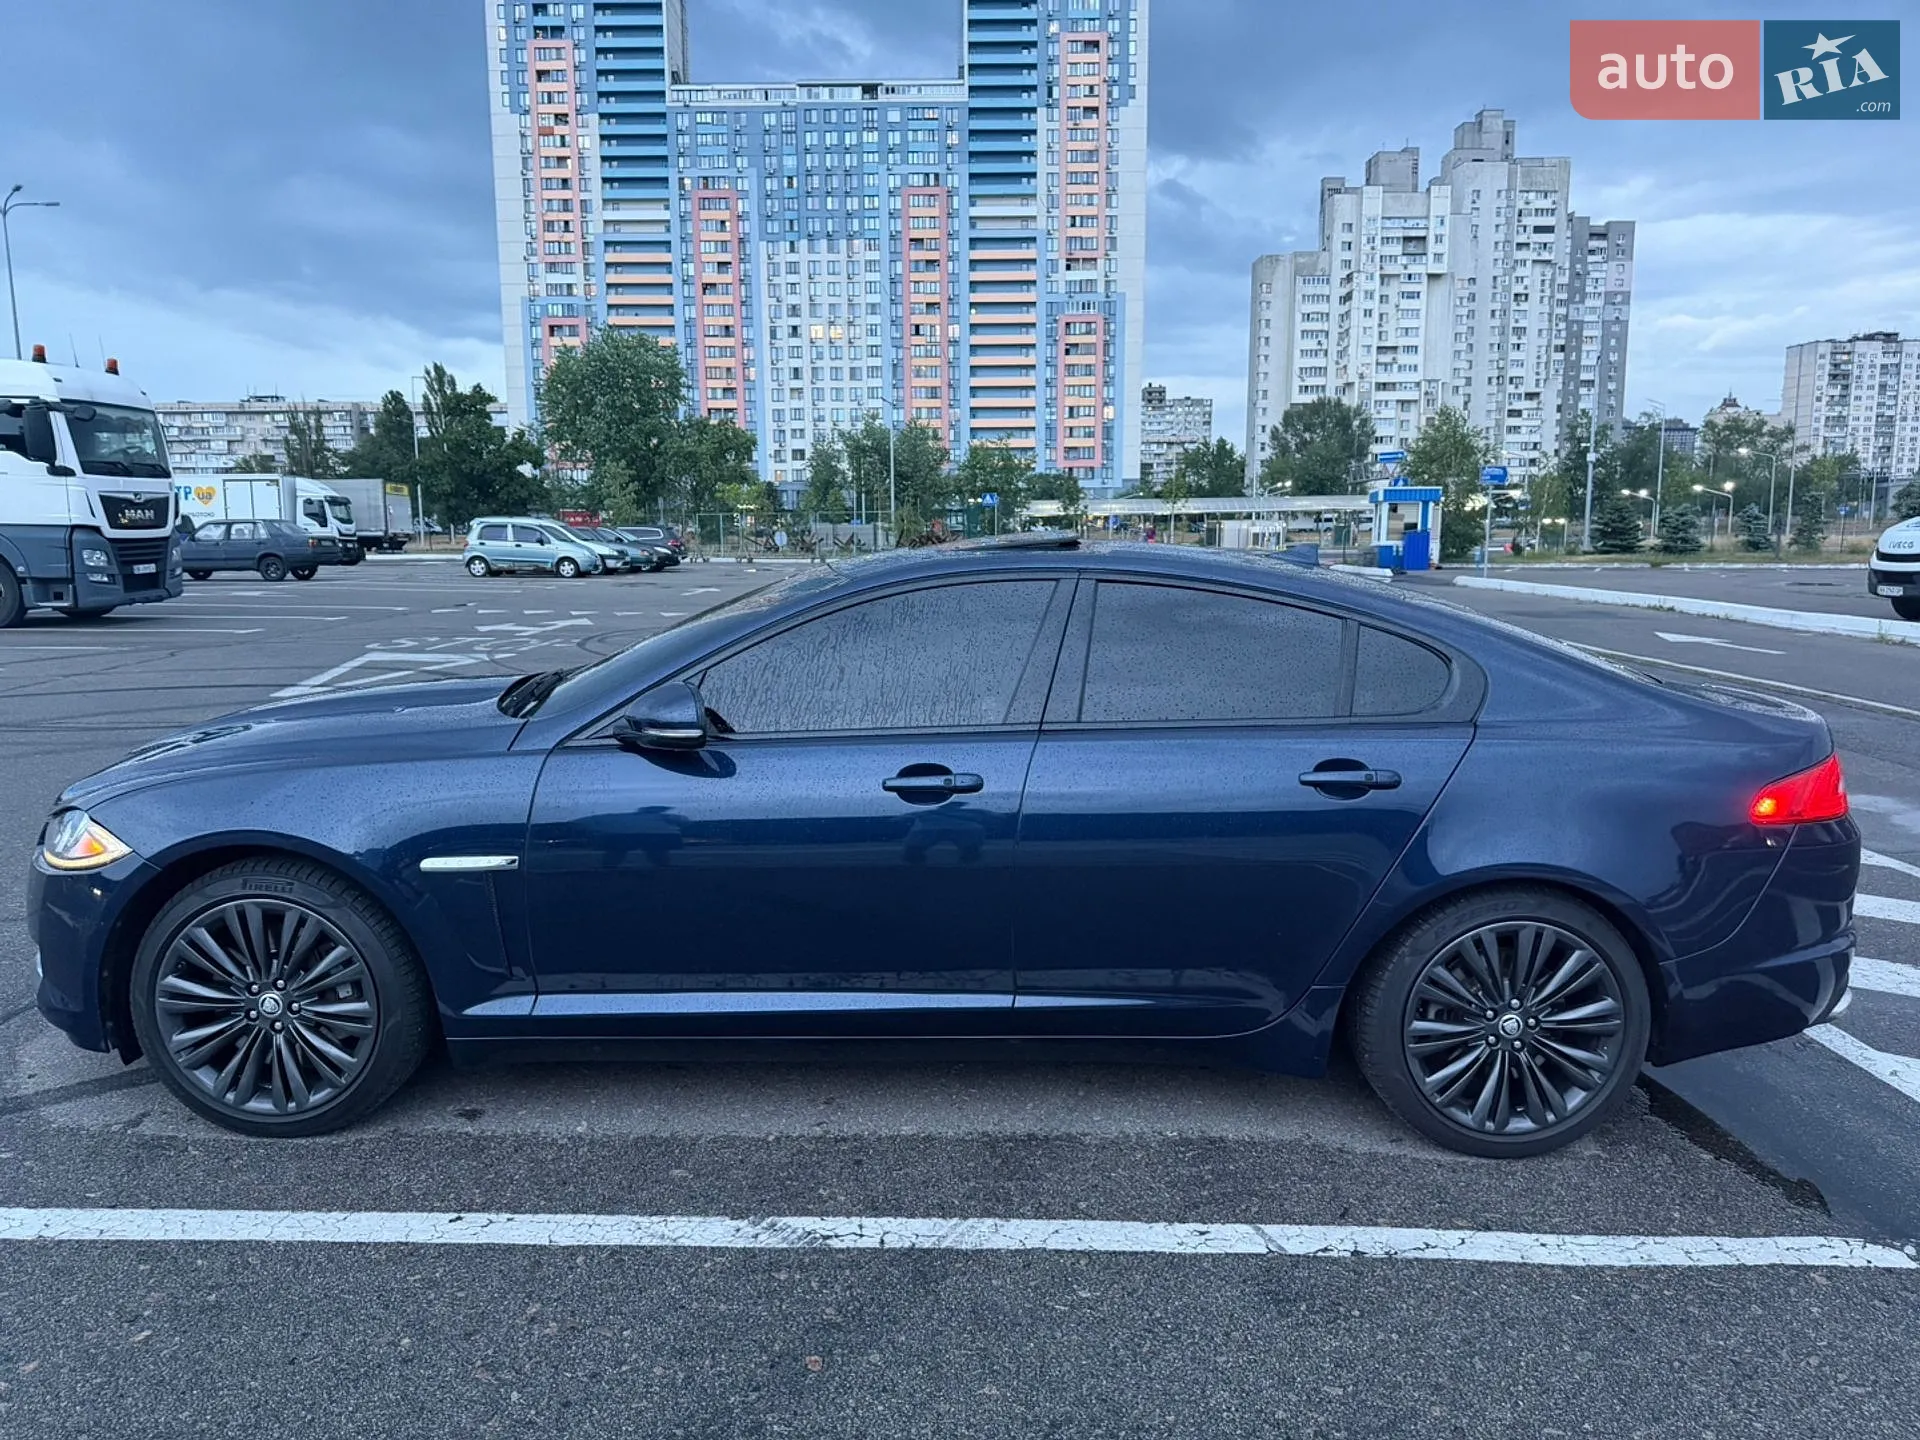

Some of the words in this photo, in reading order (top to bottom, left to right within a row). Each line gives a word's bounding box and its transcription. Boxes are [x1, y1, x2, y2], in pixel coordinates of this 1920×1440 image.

[124, 509, 155, 520] MAN
[1888, 540, 1914, 549] IVECO
[240, 877, 294, 894] PIRELLI
